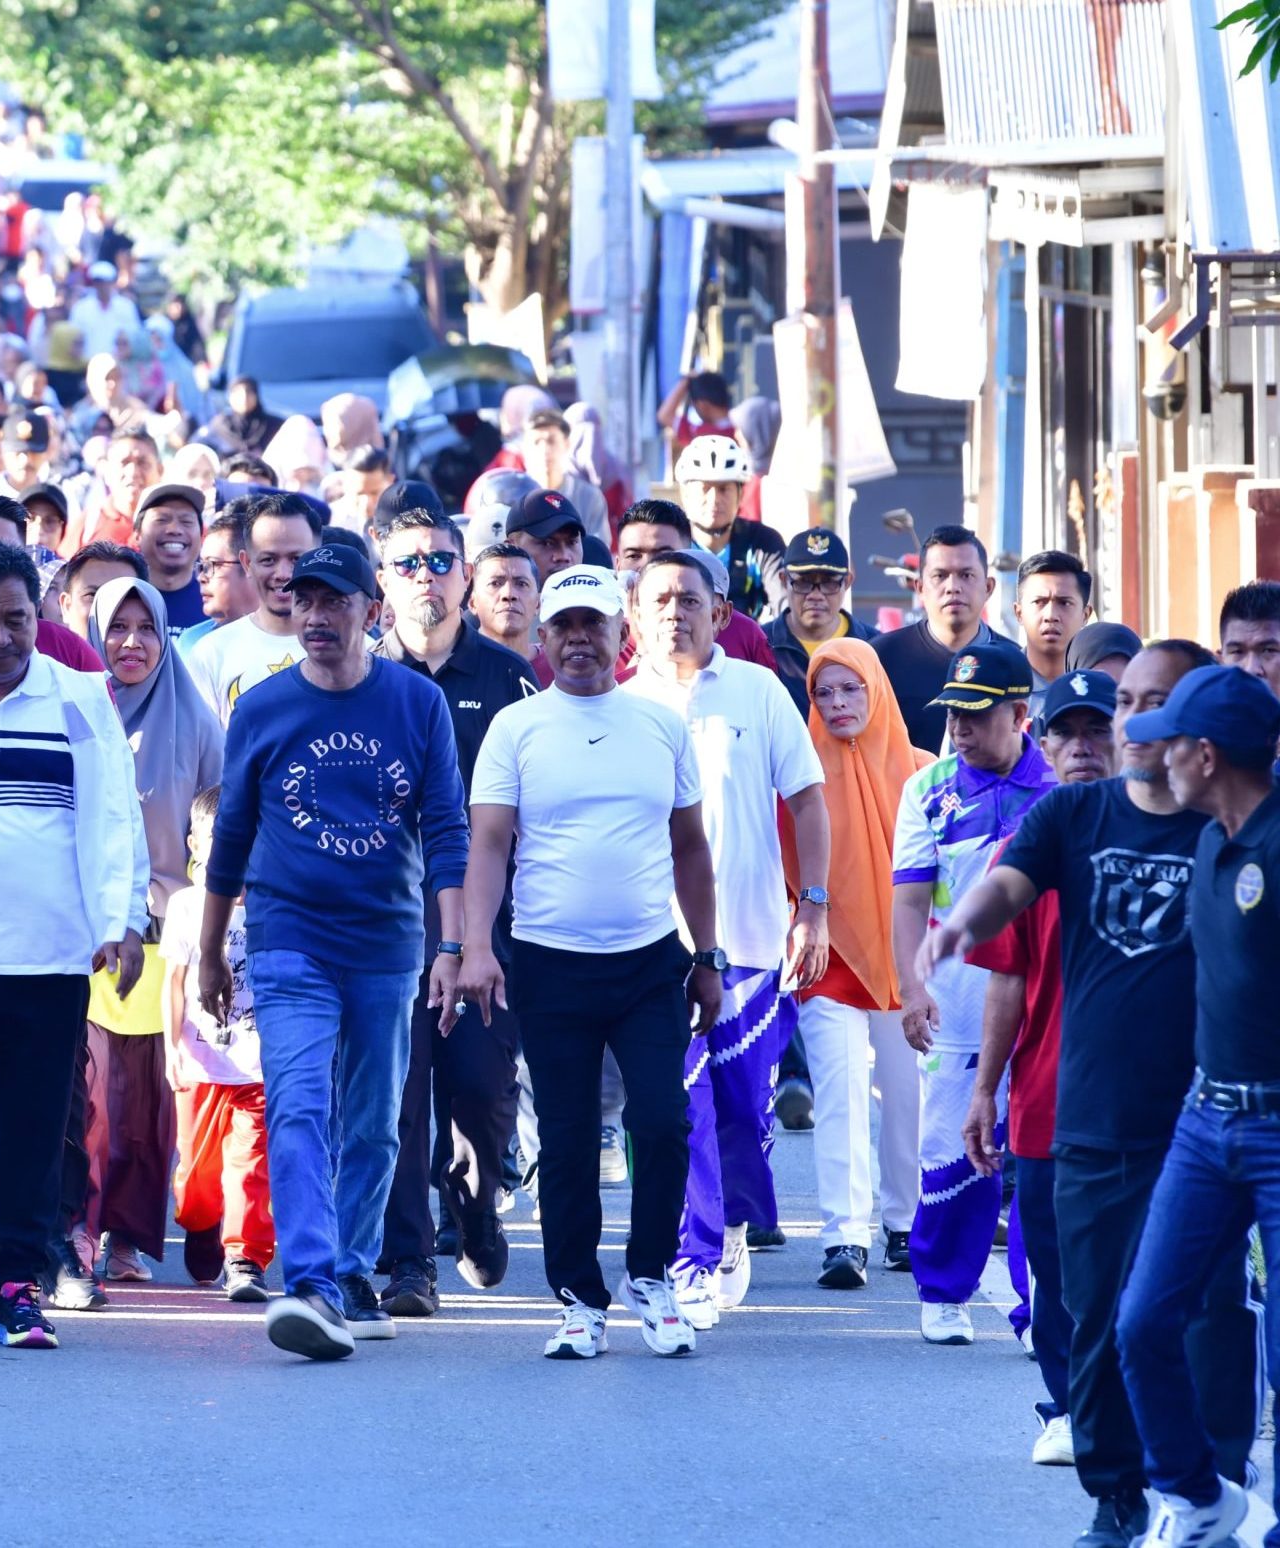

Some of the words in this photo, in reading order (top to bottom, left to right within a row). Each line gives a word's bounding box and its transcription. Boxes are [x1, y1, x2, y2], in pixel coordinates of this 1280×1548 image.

[302, 557, 343, 567] LEXUS
[308, 731, 382, 759] BOSS
[281, 761, 313, 830] BOSS
[385, 759, 411, 827] BOSS
[317, 829, 387, 857] BOSS
[1102, 856, 1189, 883] KSATRIA
